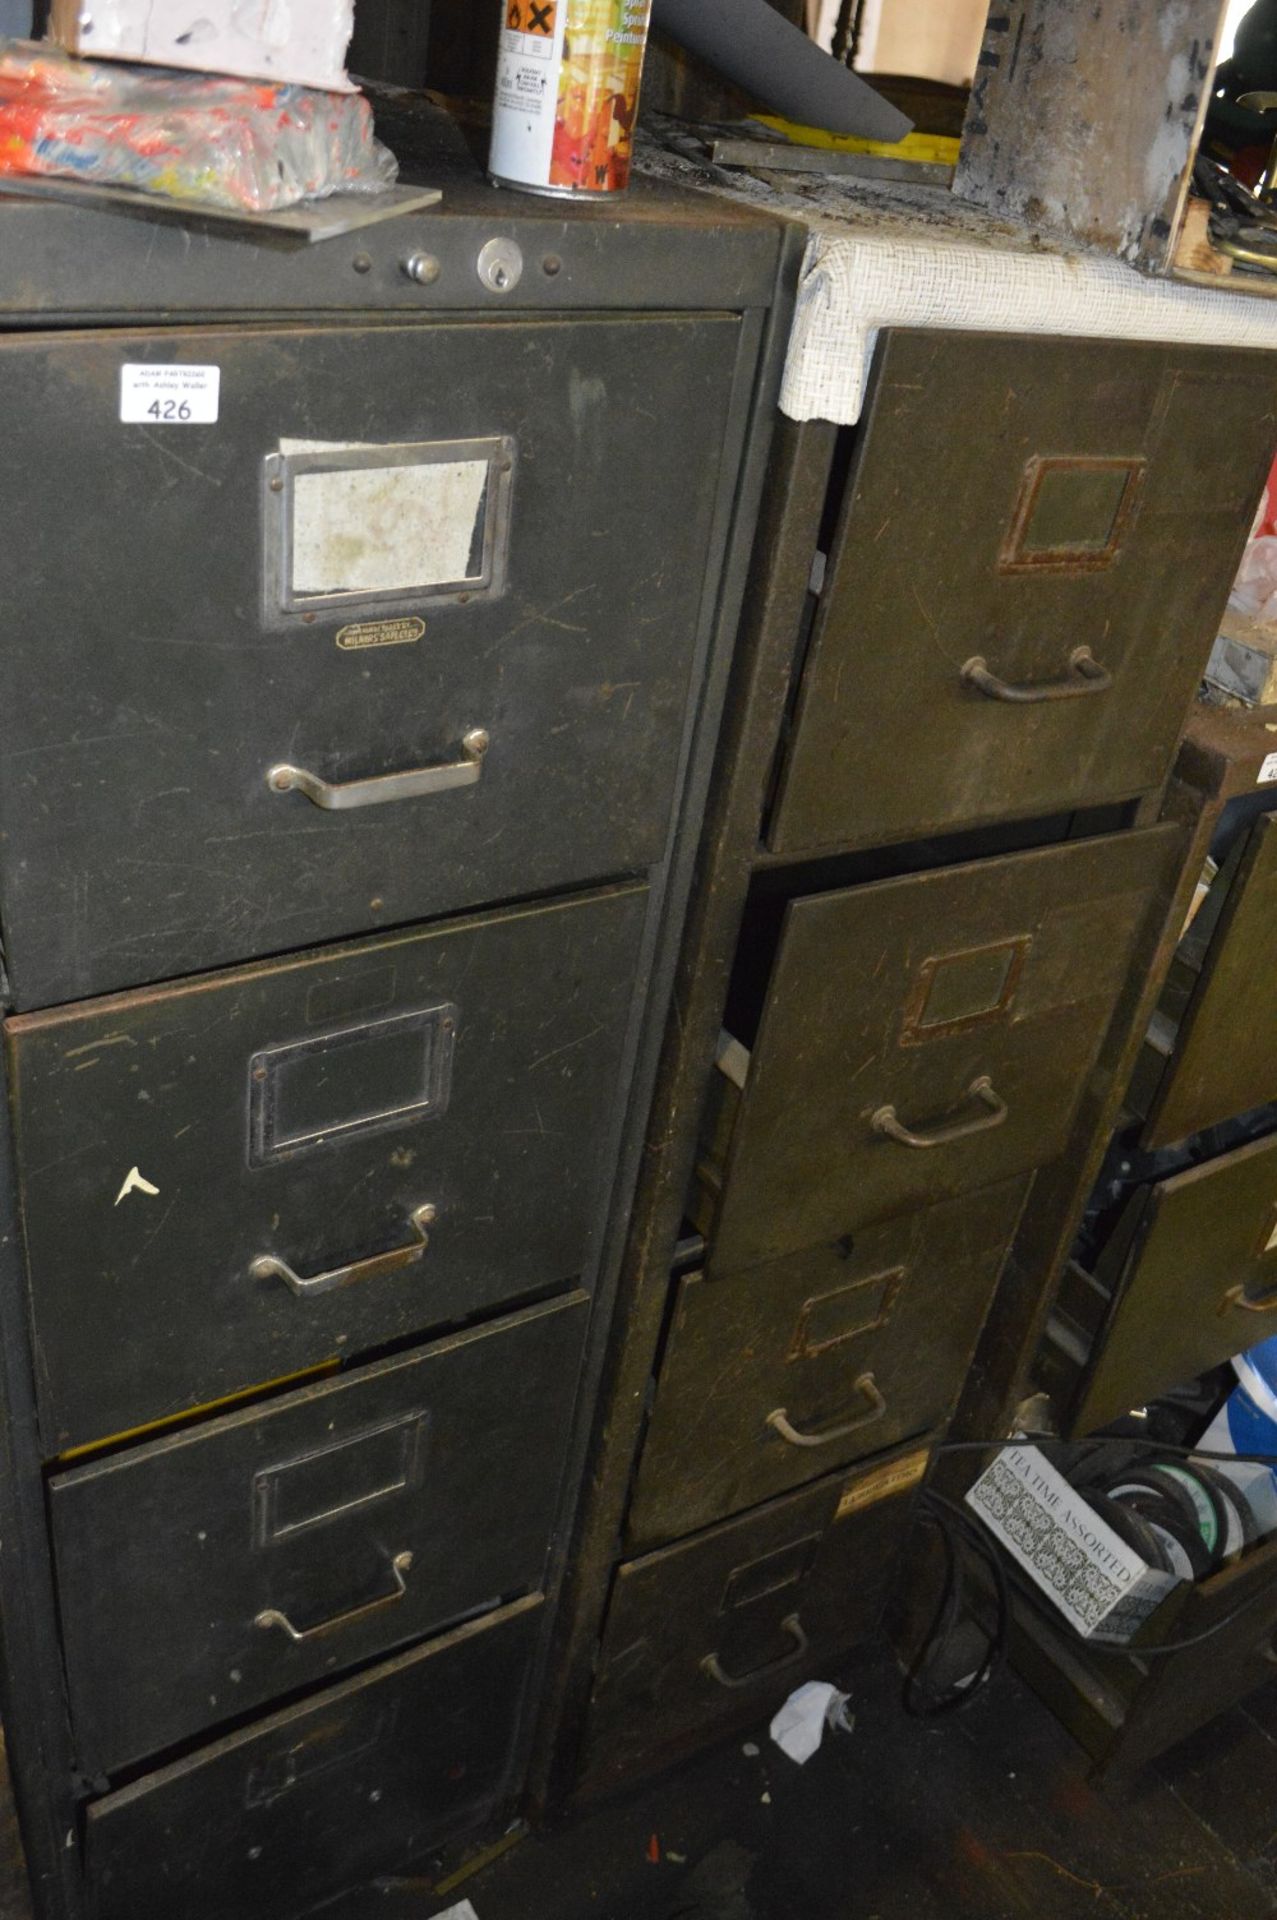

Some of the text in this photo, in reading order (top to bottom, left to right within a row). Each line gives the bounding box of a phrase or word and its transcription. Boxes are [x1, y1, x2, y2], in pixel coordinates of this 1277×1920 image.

[153, 381, 179, 391] Ashley
[147, 399, 191, 420] 426
[1009, 1450, 1132, 1583] TEA TIME ASSORTED
